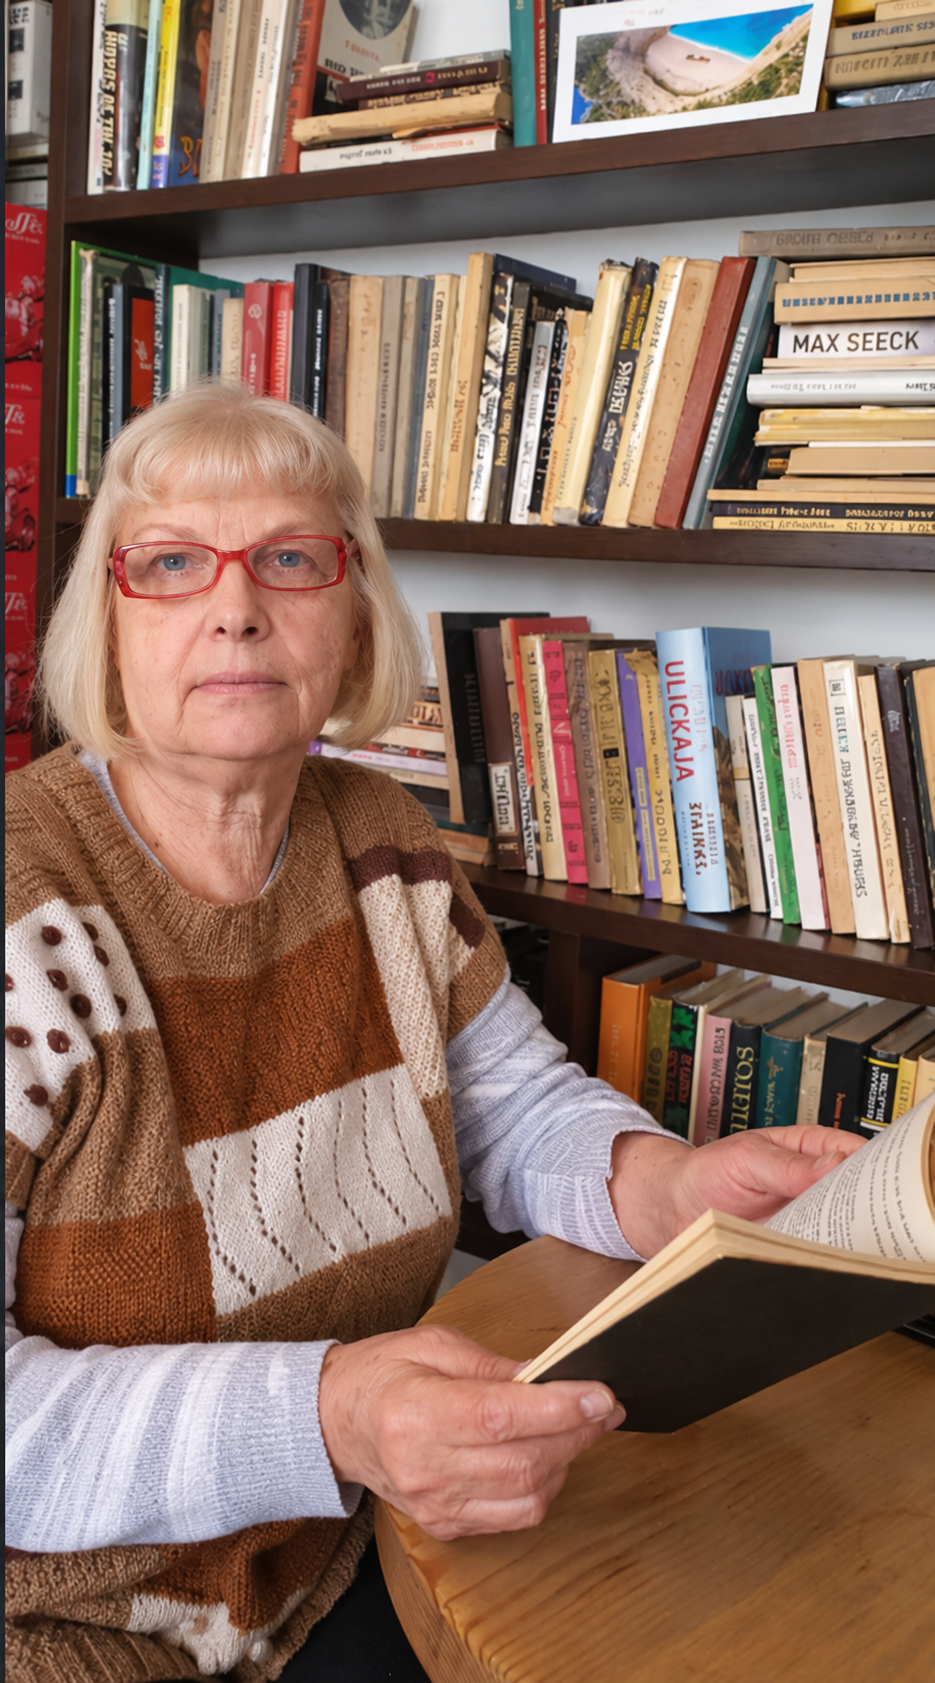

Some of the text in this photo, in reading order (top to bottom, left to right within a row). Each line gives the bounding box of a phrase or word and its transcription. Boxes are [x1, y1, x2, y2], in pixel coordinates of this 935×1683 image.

[793, 330, 920, 353] MAX SEECK
[664, 660, 695, 783] ULICKAJA
